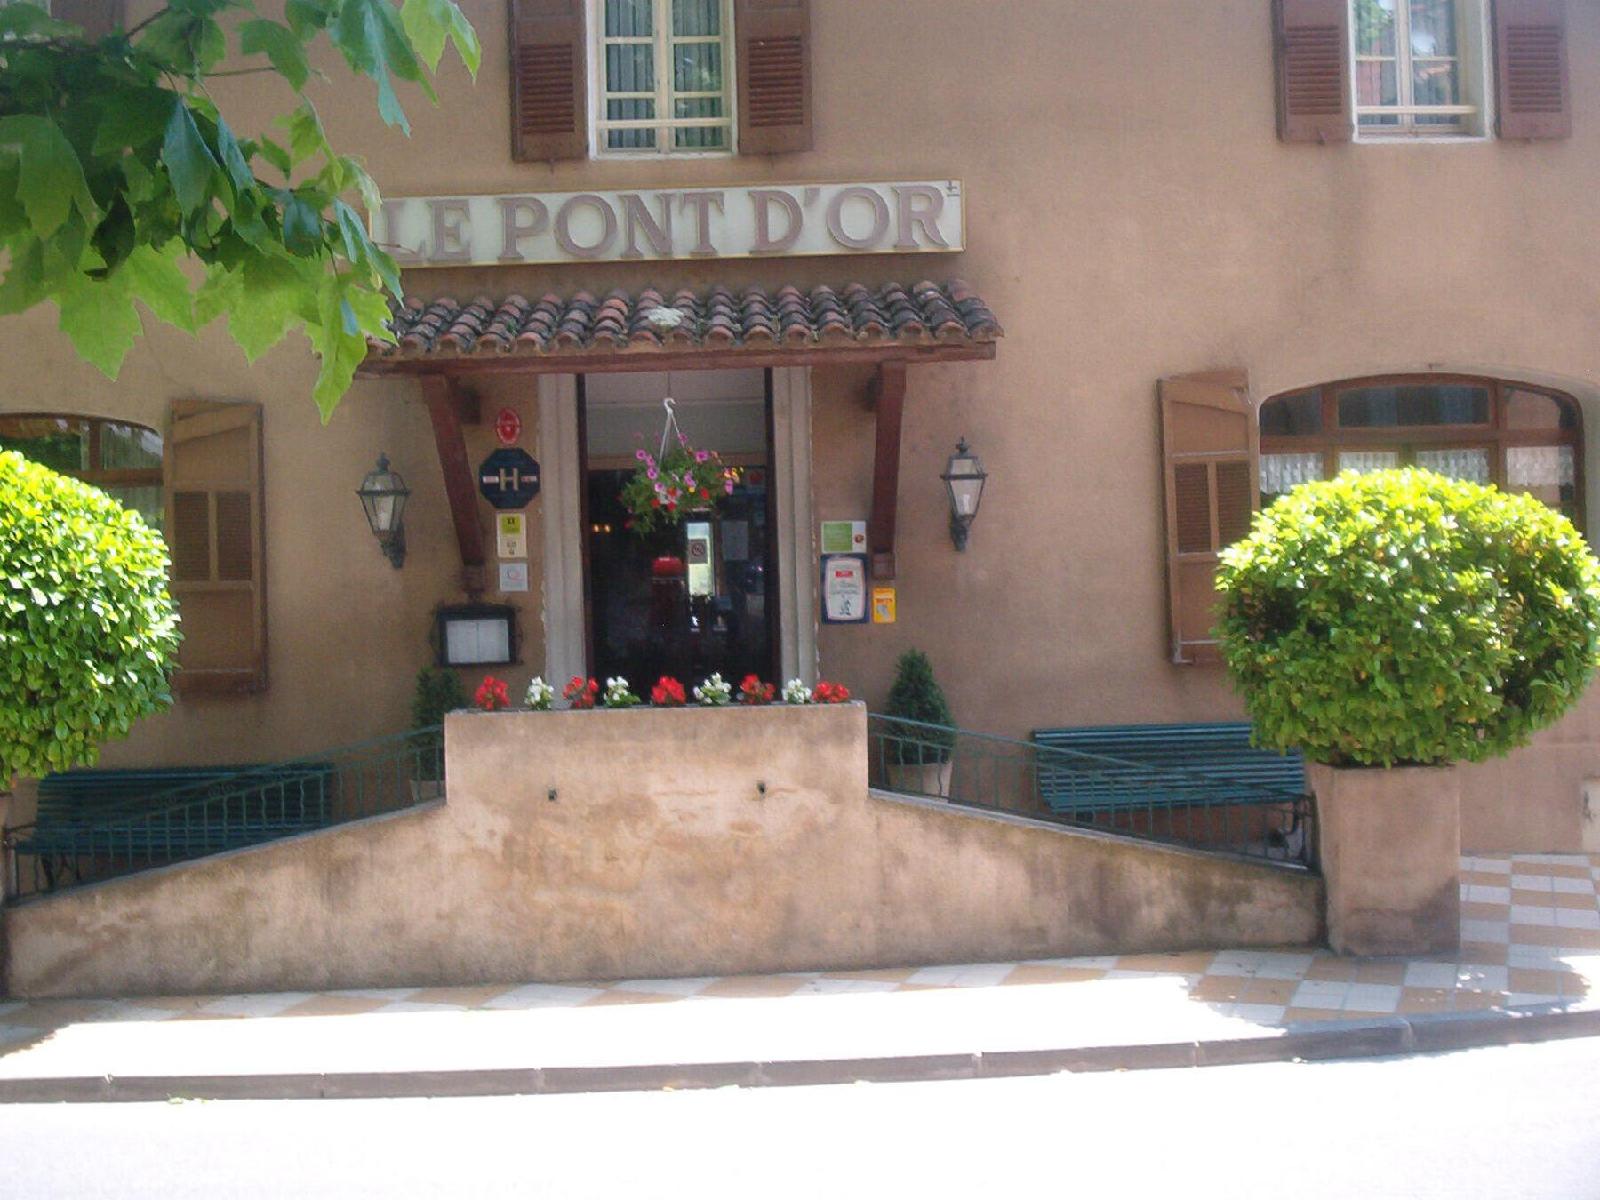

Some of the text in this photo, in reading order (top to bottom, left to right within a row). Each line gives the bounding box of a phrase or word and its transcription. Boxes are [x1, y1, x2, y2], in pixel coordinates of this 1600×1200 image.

[381, 185, 950, 265] LE PONT D'OR
